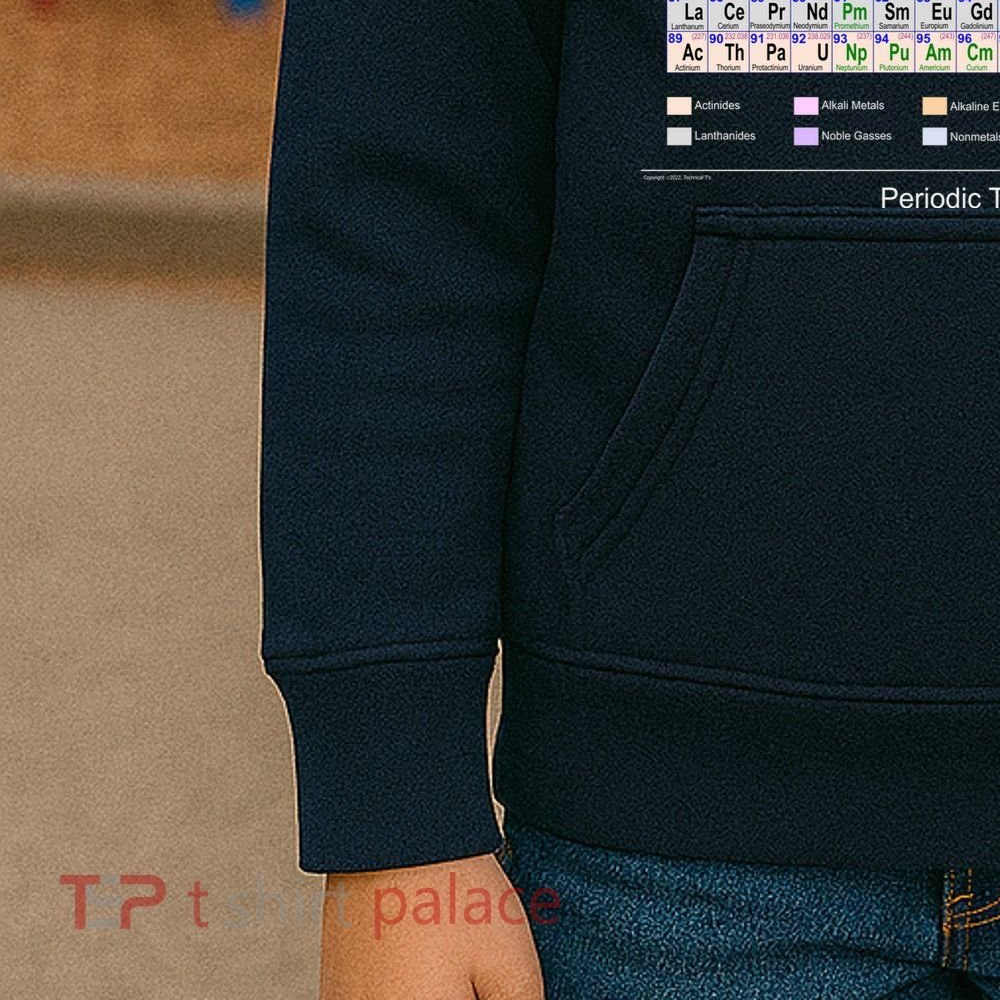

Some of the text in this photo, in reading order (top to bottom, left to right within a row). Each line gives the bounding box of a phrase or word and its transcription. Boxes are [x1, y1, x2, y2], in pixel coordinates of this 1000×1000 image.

[724, 2, 745, 21] Ce
[886, 2, 910, 21] Sm
[717, 21, 740, 29] Cerium
[878, 21, 910, 29] Samarium
[709, 33, 724, 44] 90
[724, 43, 745, 61] Th
[716, 63, 741, 71] Thorium
[695, 100, 740, 110] Actinides
[822, 100, 884, 110] Alkali Metals
[950, 102, 989, 111] Alkaline
[695, 131, 756, 140] Lanthanides
[822, 131, 892, 140] Noble Gasses
[882, 187, 981, 208] Periodic
